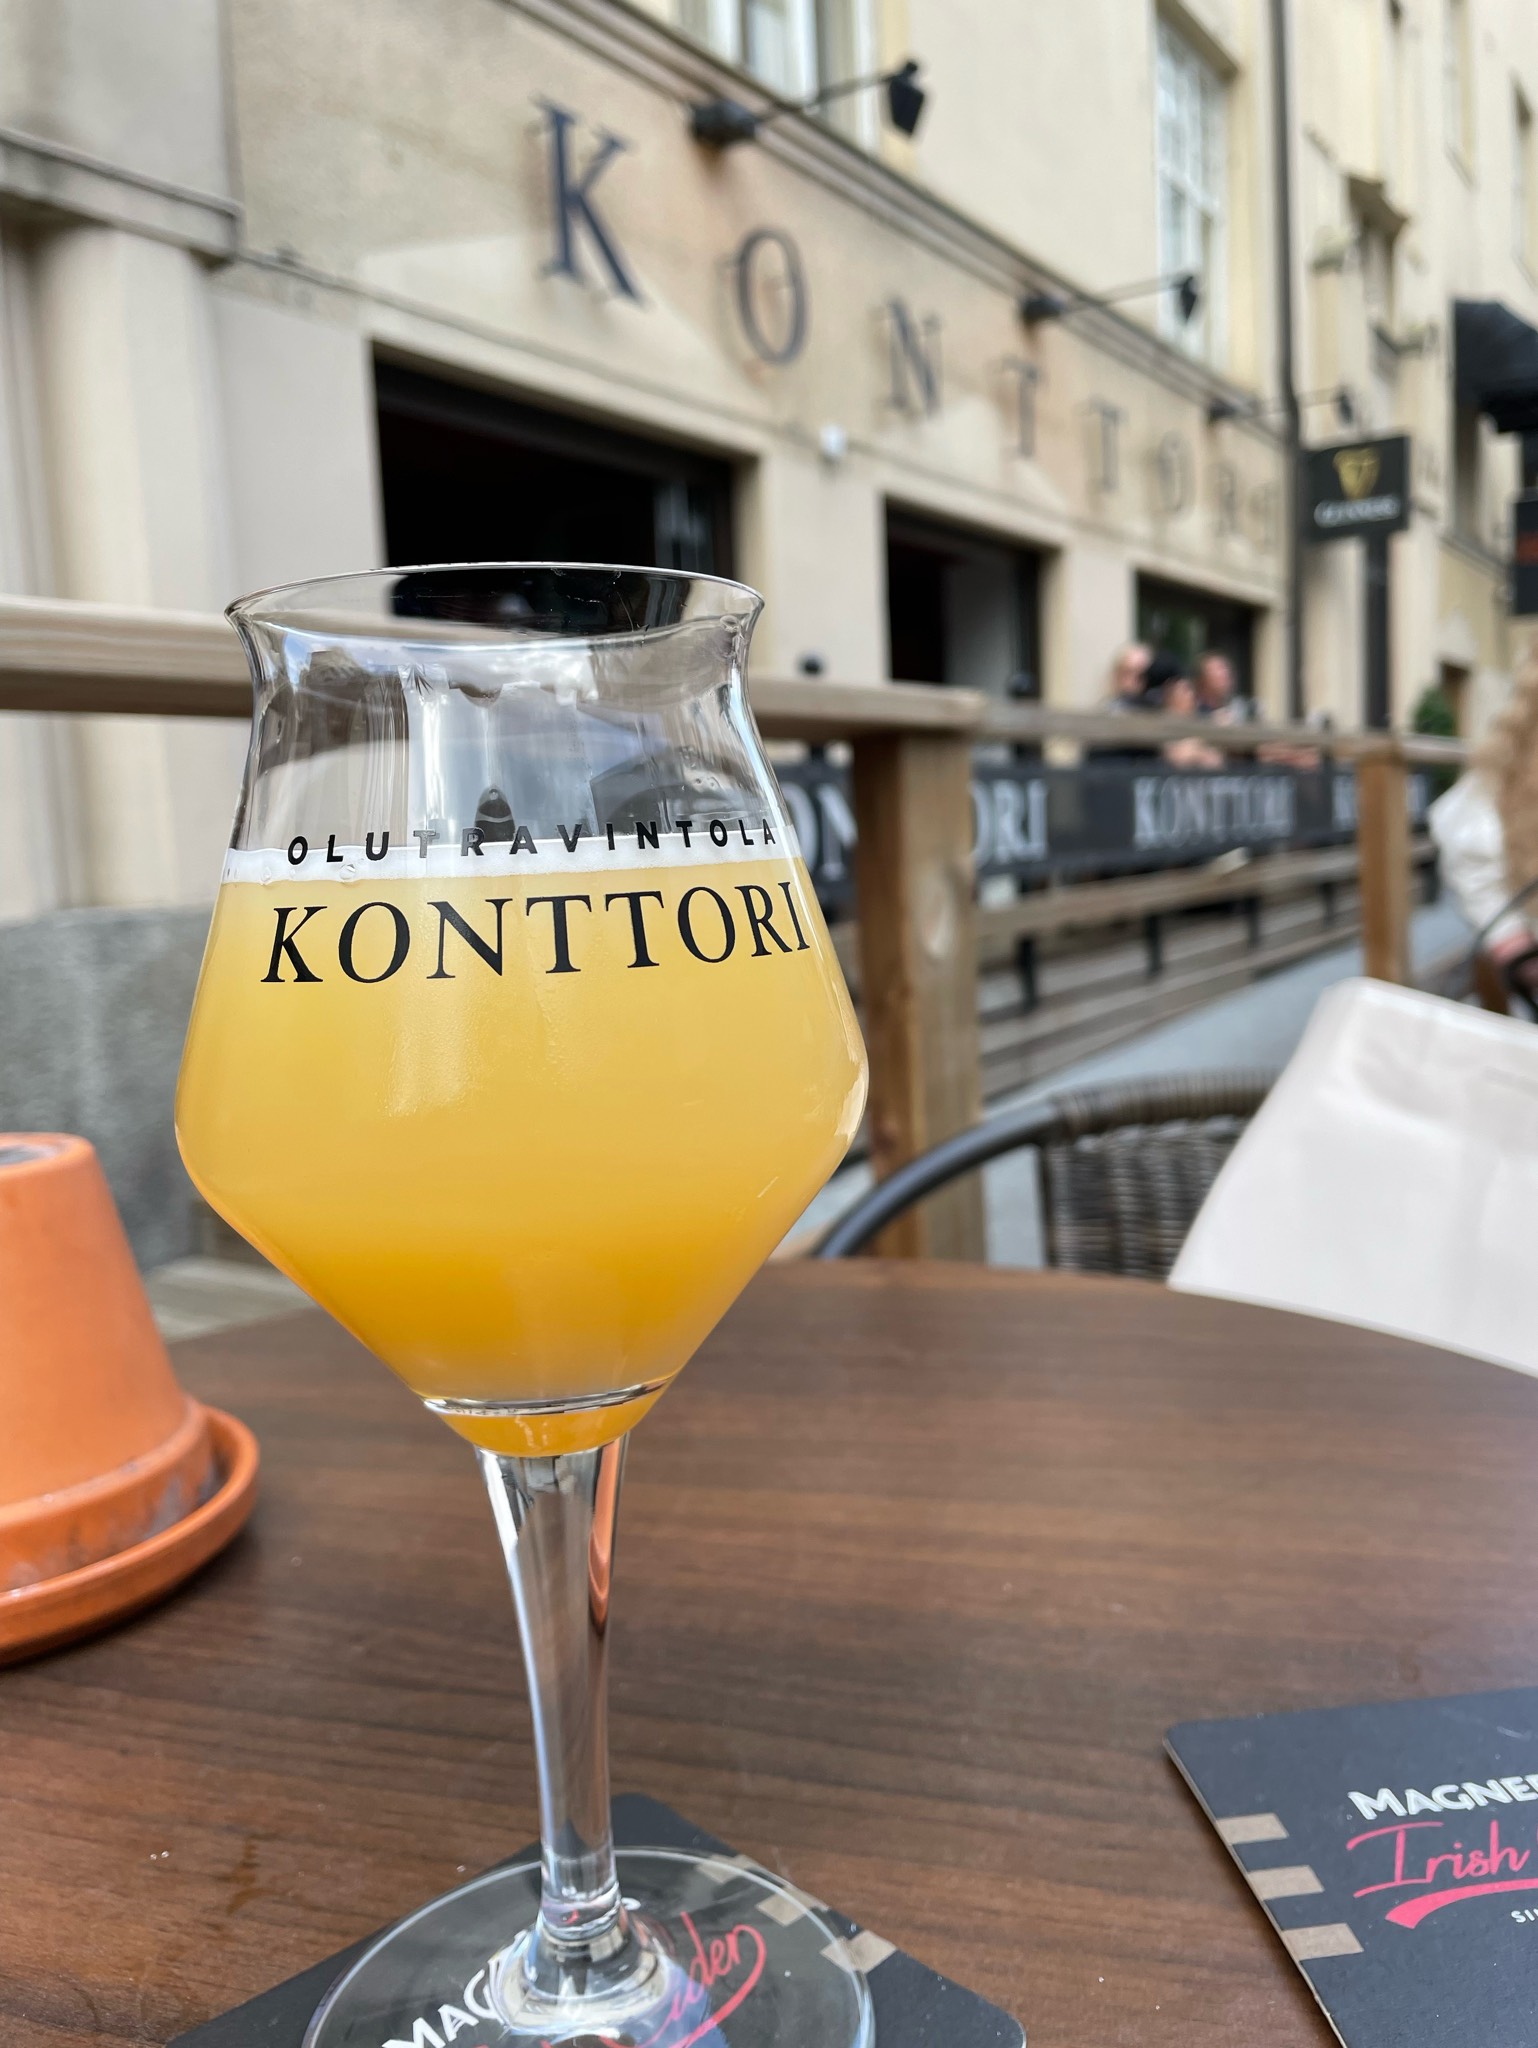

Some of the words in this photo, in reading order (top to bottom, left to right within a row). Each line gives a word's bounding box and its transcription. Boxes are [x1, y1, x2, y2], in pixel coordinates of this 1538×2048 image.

[288, 818, 776, 866] OLUTRAVINTOLA
[260, 881, 811, 984] KONTTORI
[1346, 1818, 1531, 1899] Irish
